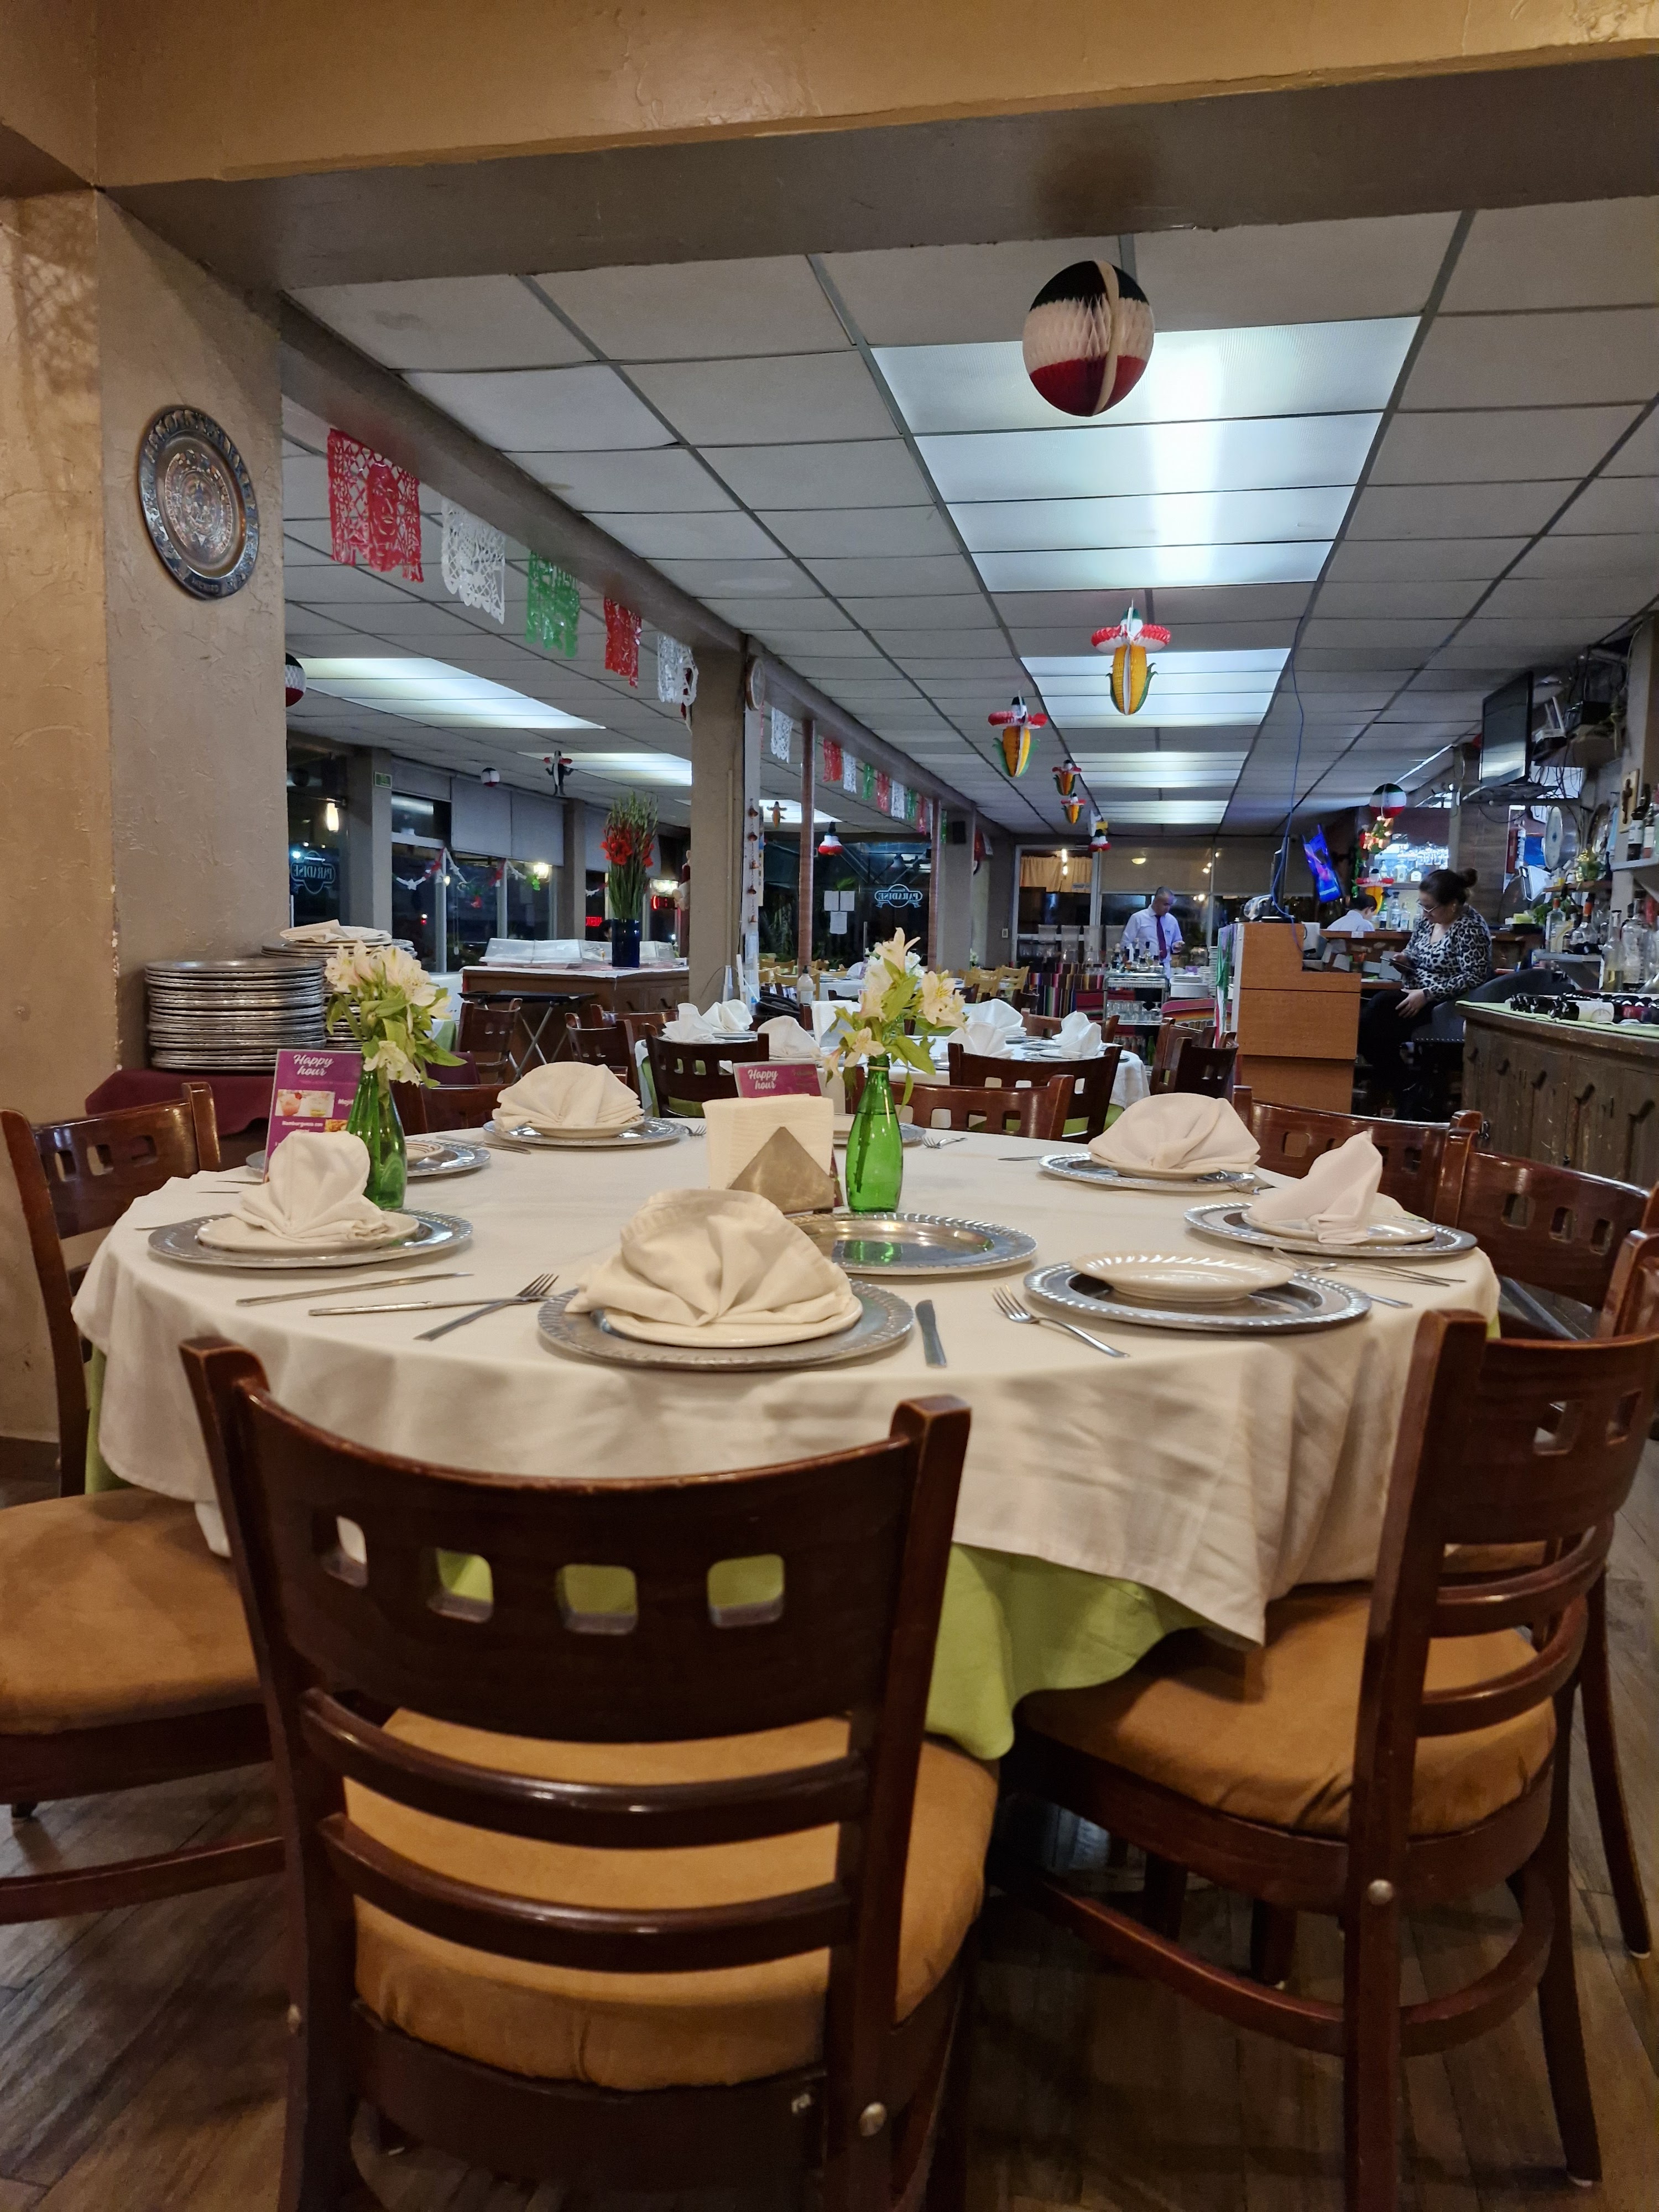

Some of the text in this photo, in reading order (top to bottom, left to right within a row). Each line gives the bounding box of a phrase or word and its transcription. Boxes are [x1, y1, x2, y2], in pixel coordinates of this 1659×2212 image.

[293, 1054, 334, 1068] Happy
[297, 1065, 327, 1076] hour
[748, 1069, 779, 1081] Happy
[755, 1079, 777, 1090] hour
